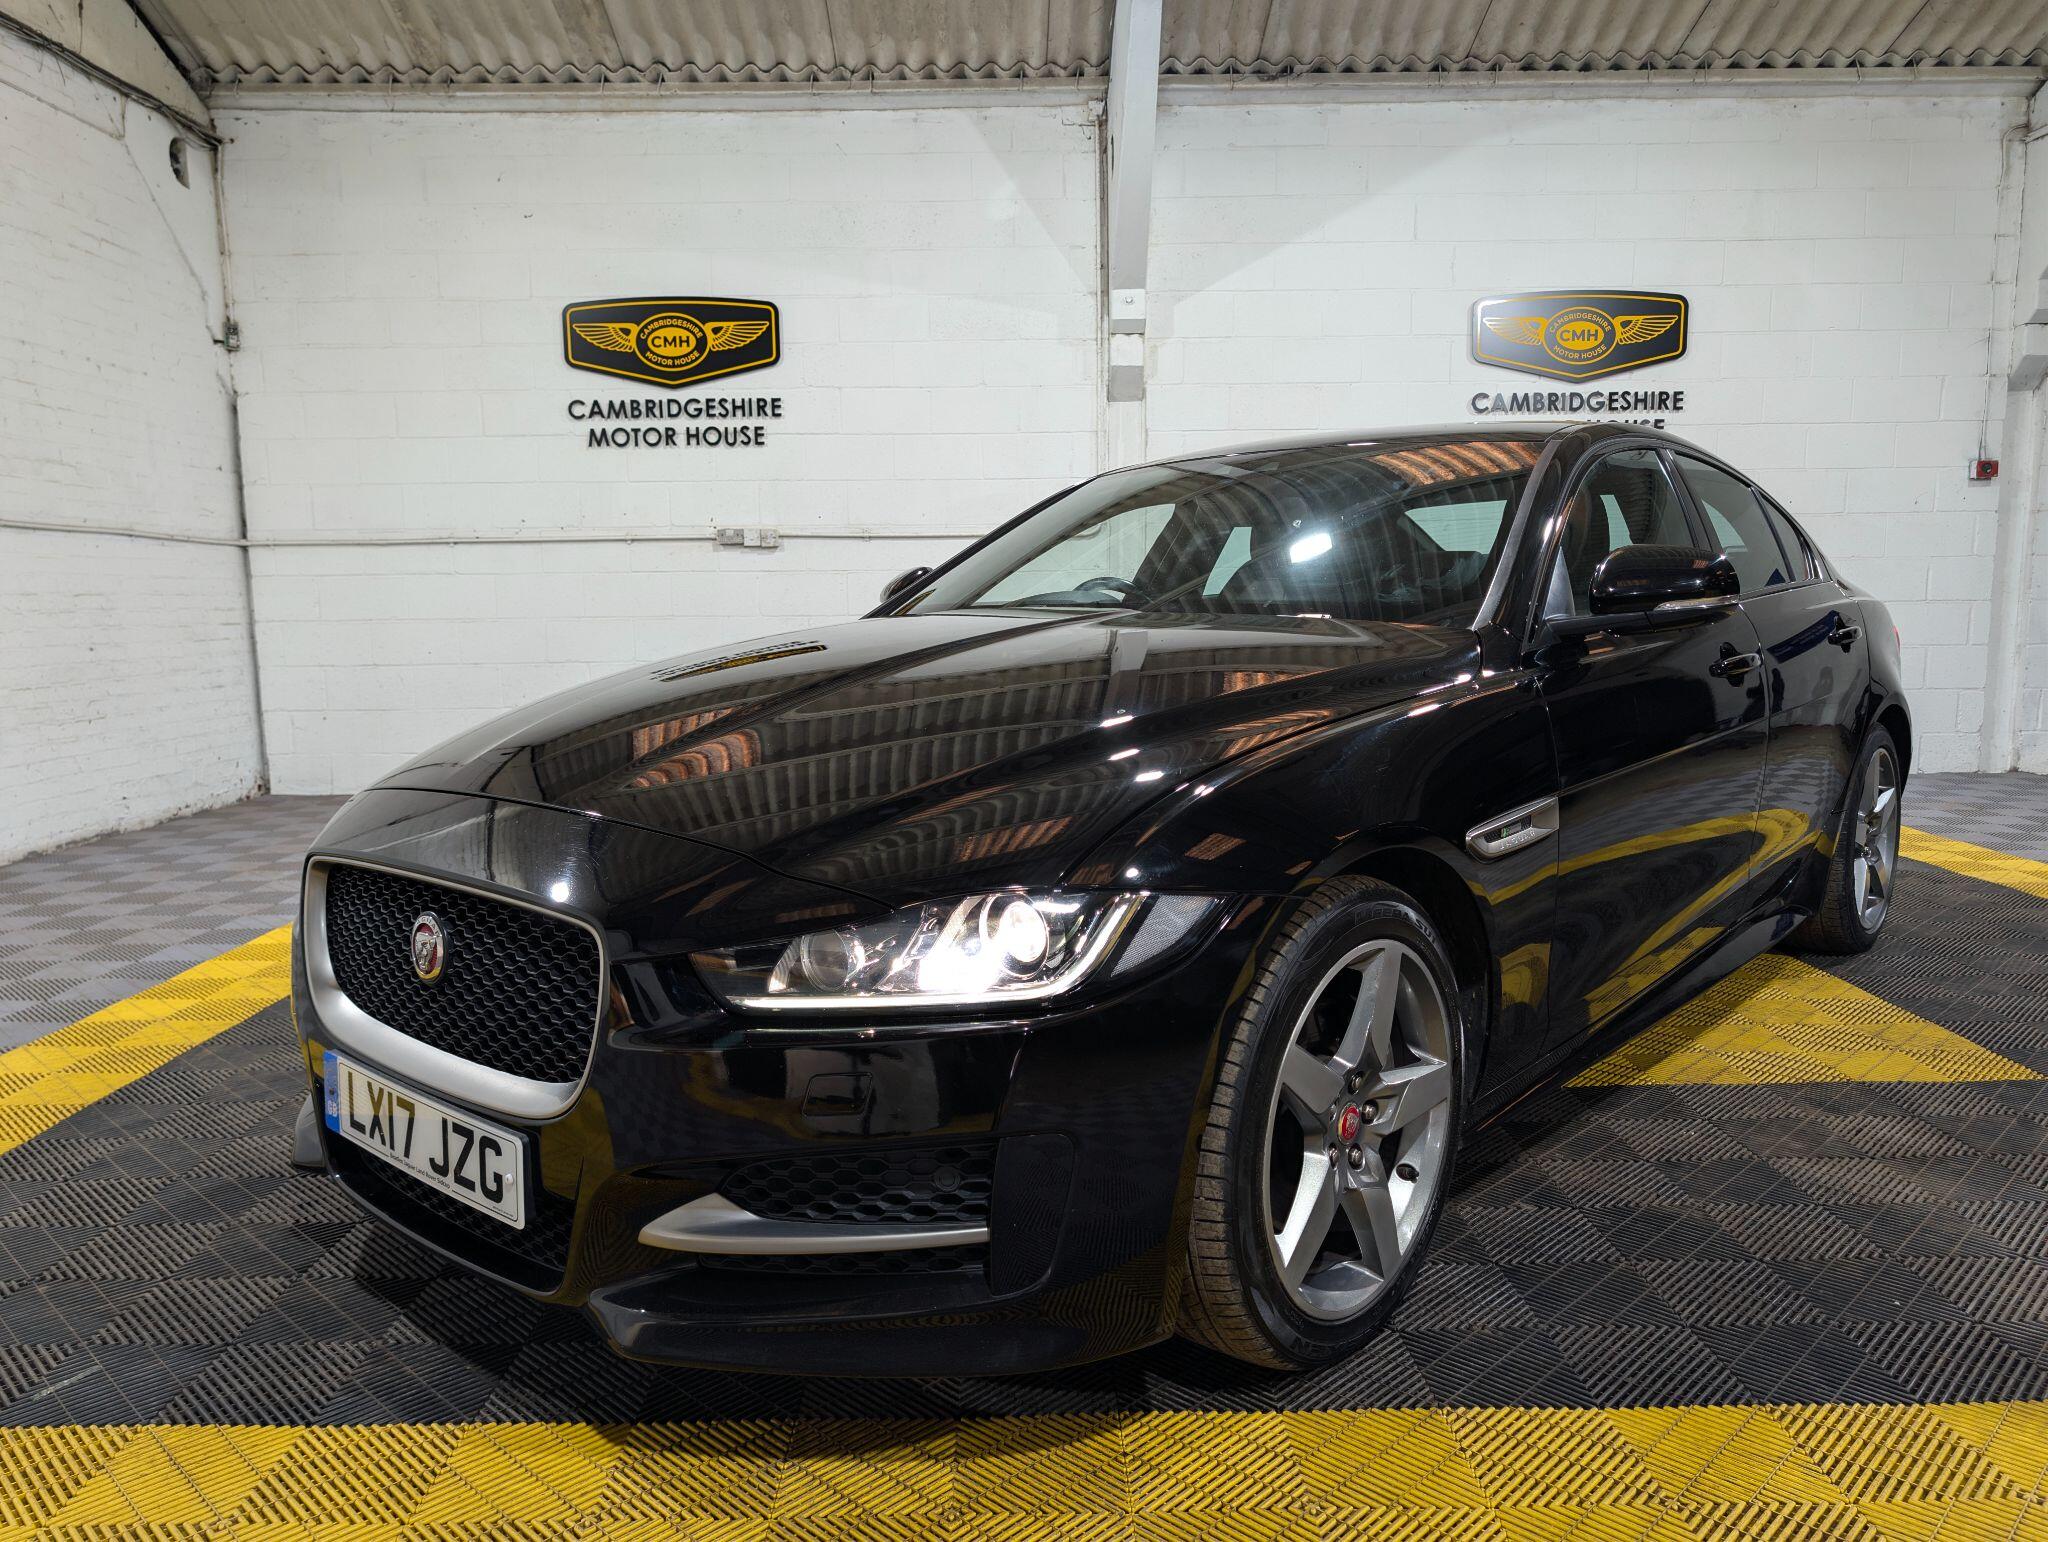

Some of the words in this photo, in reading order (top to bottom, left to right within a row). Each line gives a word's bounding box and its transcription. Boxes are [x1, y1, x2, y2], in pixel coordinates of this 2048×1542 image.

[640, 319, 703, 340] CAMBRIDGESHIRE
[1550, 313, 1612, 333] CAMBRIDGESHIRE
[651, 335, 690, 348] CMH
[1560, 329, 1599, 342] CMH
[645, 351, 673, 366] MOTOR
[674, 350, 700, 366] HOUSE
[1554, 344, 1580, 360] MOTOR
[1581, 343, 1607, 359] HOUSE
[568, 397, 782, 421] CAMBRIDGESHIRE
[1471, 390, 1685, 413] CAMBRIDGESHIRE
[588, 427, 677, 448] MOTOR
[686, 425, 766, 447] HOUSE
[348, 1071, 416, 1159] LX17
[428, 1116, 504, 1204] JZG
